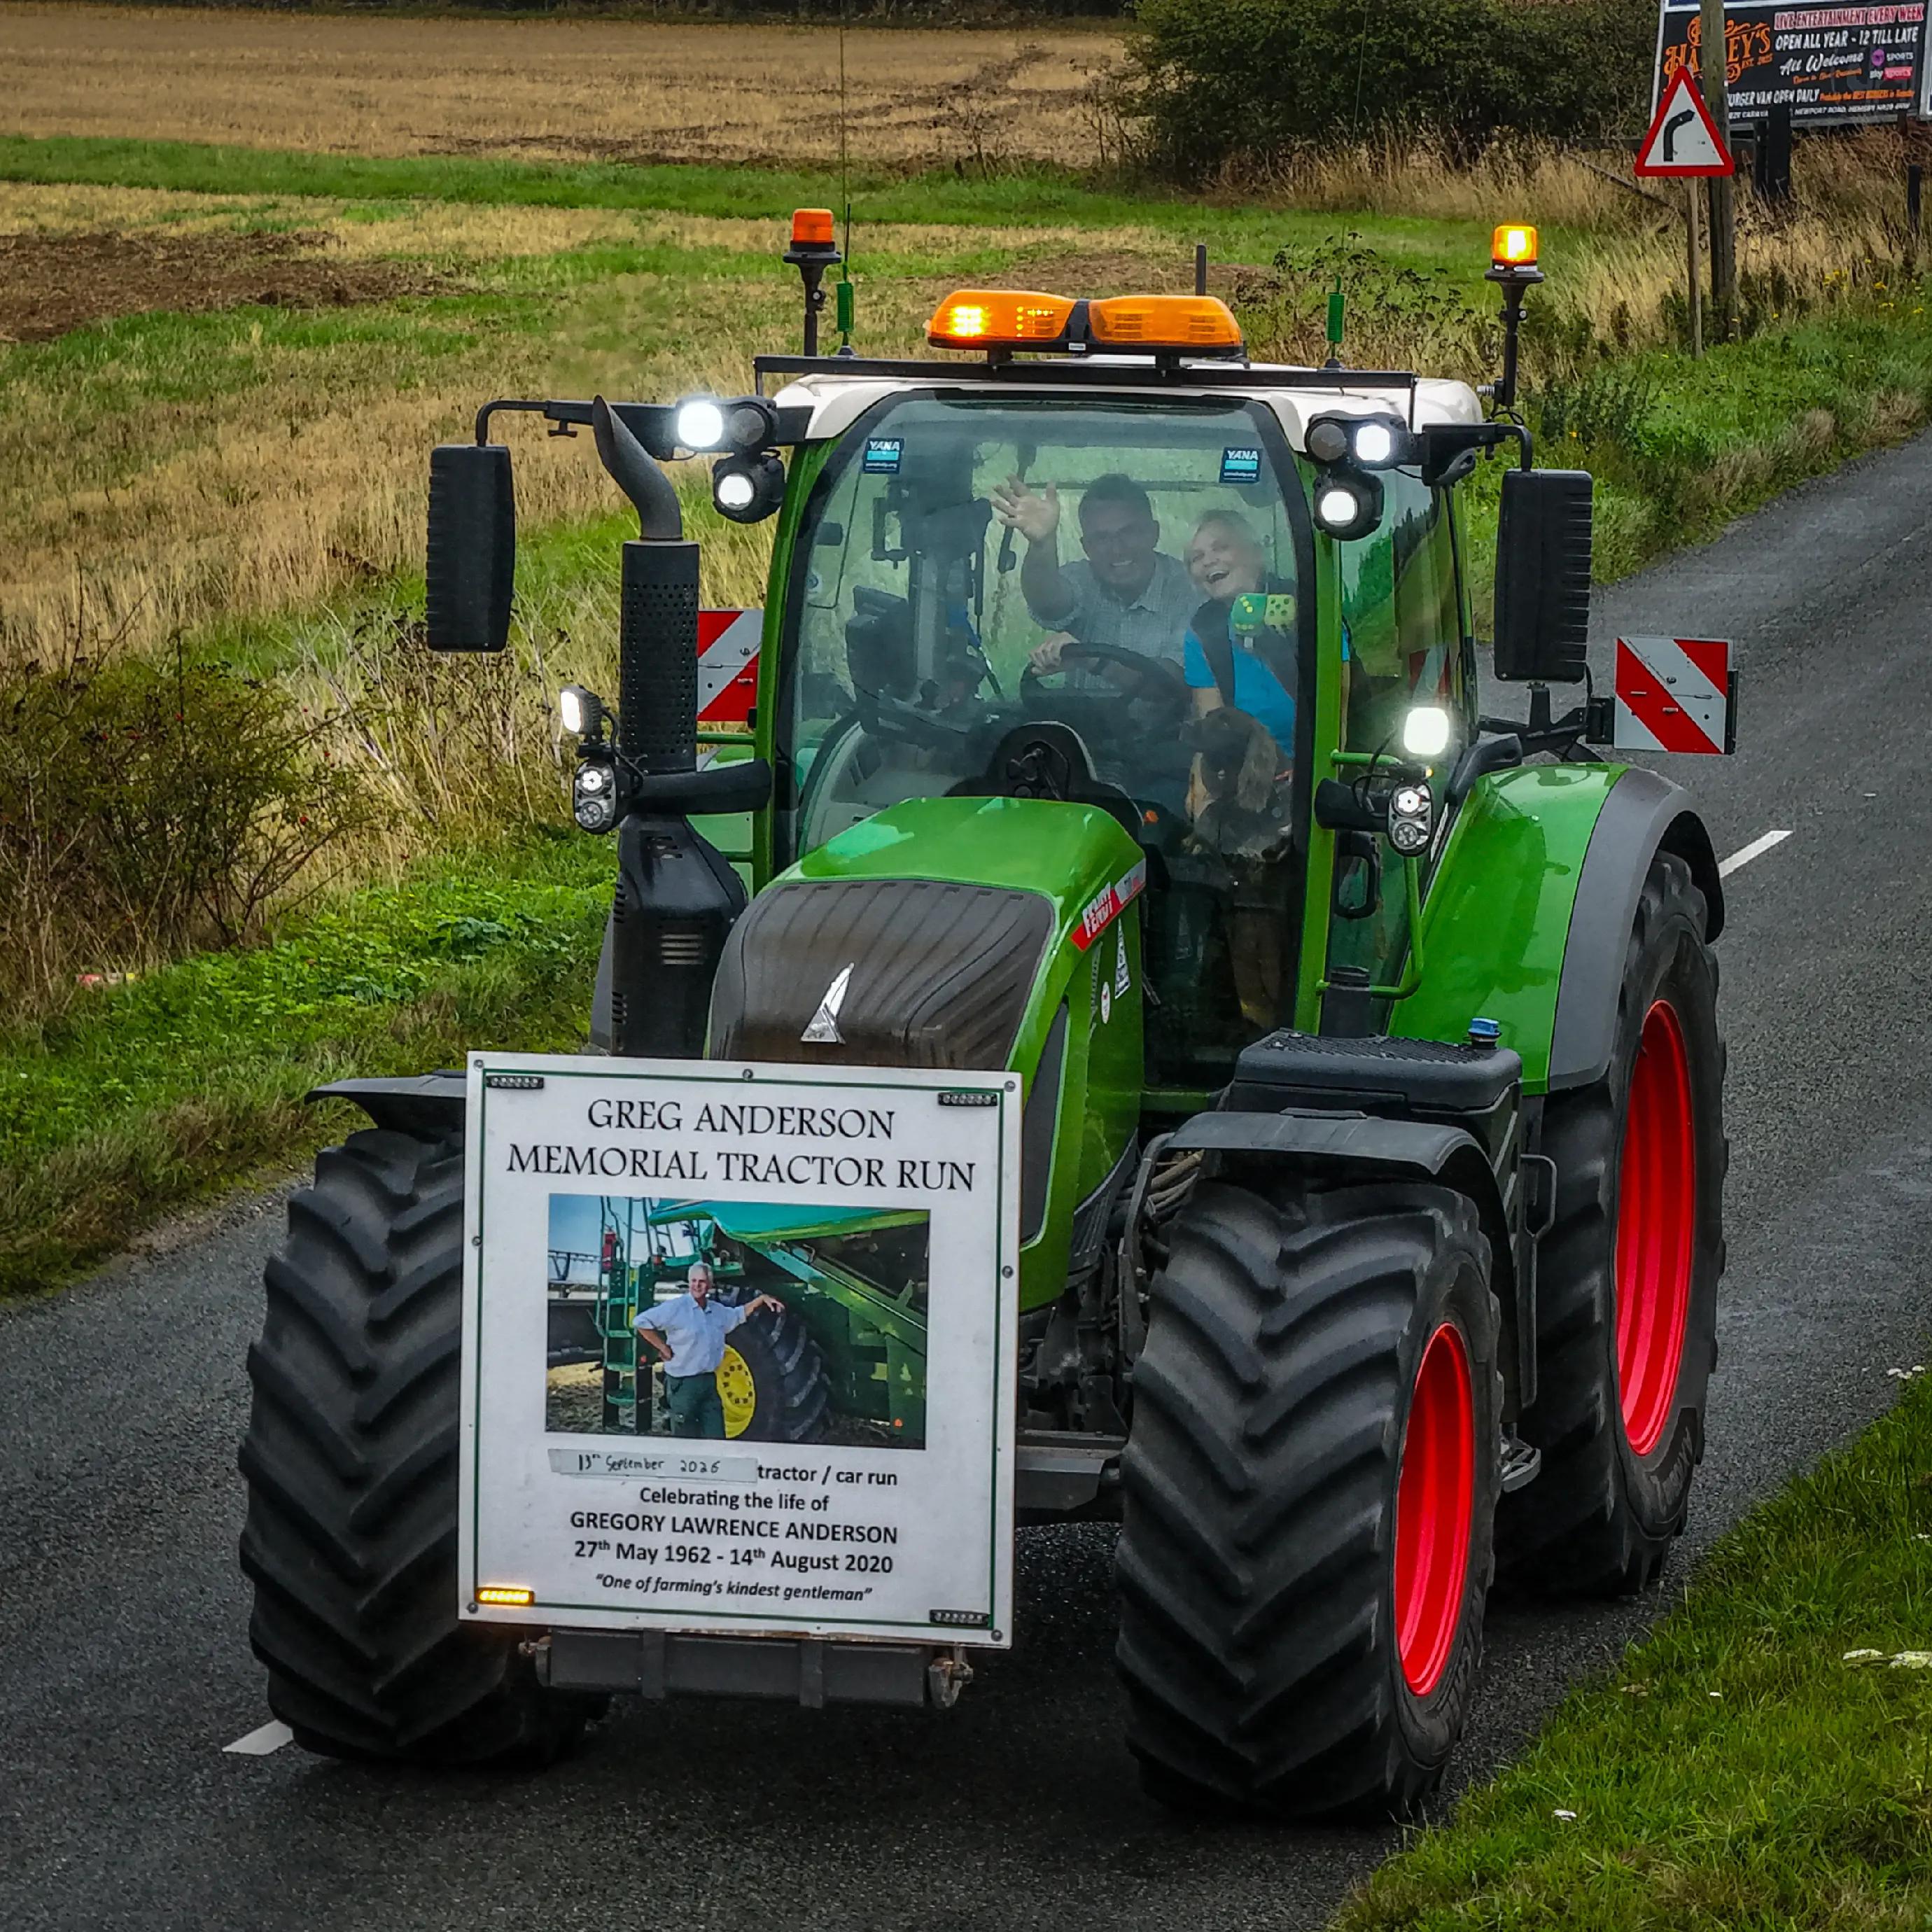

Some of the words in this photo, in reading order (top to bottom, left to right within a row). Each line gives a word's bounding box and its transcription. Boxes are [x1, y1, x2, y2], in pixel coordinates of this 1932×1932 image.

[1795, 7, 1867, 29] ENTERTAINMENT
[1867, 5, 1898, 24] EVERY
[1897, 3, 1924, 22] WEEK
[1774, 34, 1802, 51] OPEN
[1802, 33, 1821, 49] ALL
[1823, 29, 1848, 48] YEAR
[1858, 29, 1870, 45] 12
[1872, 29, 1893, 45] TILL
[1894, 27, 1919, 43] LATE
[1805, 52, 1864, 73] Welcome
[1886, 52, 1914, 62] SPORTS
[1756, 90, 1773, 104] VAN
[1773, 89, 1795, 104] OPEN
[1796, 88, 1820, 103] DAILY
[869, 441, 900, 451] YANA
[1227, 450, 1259, 461] YANA
[587, 1099, 682, 1131] GREG
[693, 1103, 896, 1140] ANDERSON
[506, 1143, 708, 1180] MEMORIAL
[716, 1152, 887, 1188] TRACTOR
[897, 1159, 976, 1191] RUN
[606, 1455, 664, 1472] September
[757, 1465, 818, 1482] tractor
[821, 1465, 832, 1485] /
[836, 1471, 863, 1483] car
[867, 1472, 897, 1485] run
[640, 1488, 740, 1510] Celebrating
[744, 1492, 773, 1508] the
[778, 1493, 805, 1511] life
[811, 1495, 830, 1511] of
[570, 1511, 666, 1532] GREGORY
[671, 1516, 780, 1538] LAWRENCE
[785, 1522, 897, 1544] ANDERSON
[574, 1540, 610, 1558] 27th
[615, 1543, 659, 1564] May
[664, 1544, 711, 1564] 1962
[729, 1547, 766, 1567] 14th
[771, 1550, 840, 1574] August
[845, 1554, 894, 1574] 2020
[596, 1573, 631, 1589] “One
[635, 1576, 652, 1593] of
[652, 1576, 722, 1596] farming’s
[726, 1581, 780, 1597] kindest
[783, 1585, 873, 1602] gentleman”
